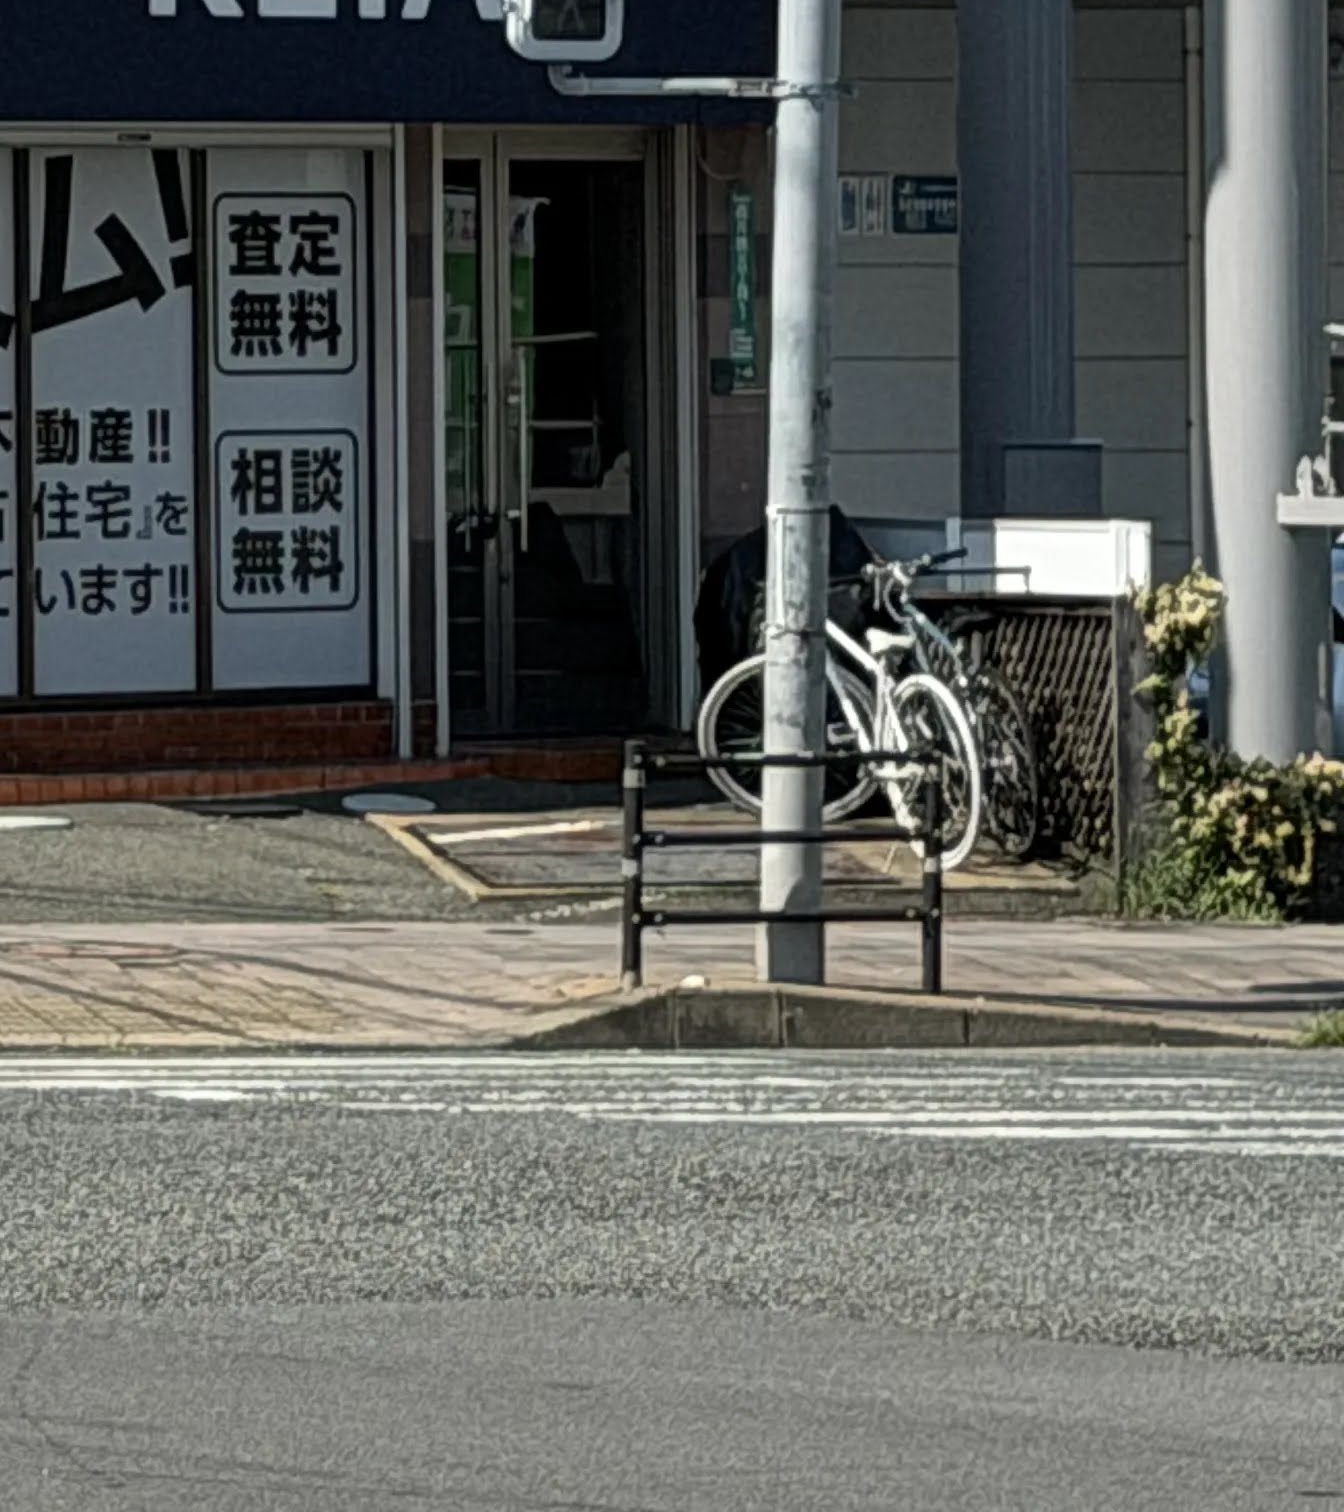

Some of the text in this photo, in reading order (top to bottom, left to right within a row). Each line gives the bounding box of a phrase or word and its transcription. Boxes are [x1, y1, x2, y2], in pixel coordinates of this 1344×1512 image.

[228, 210, 343, 278] 査定
[228, 290, 343, 358] 無料
[230, 447, 344, 516] 相談
[231, 526, 344, 596] 無料
